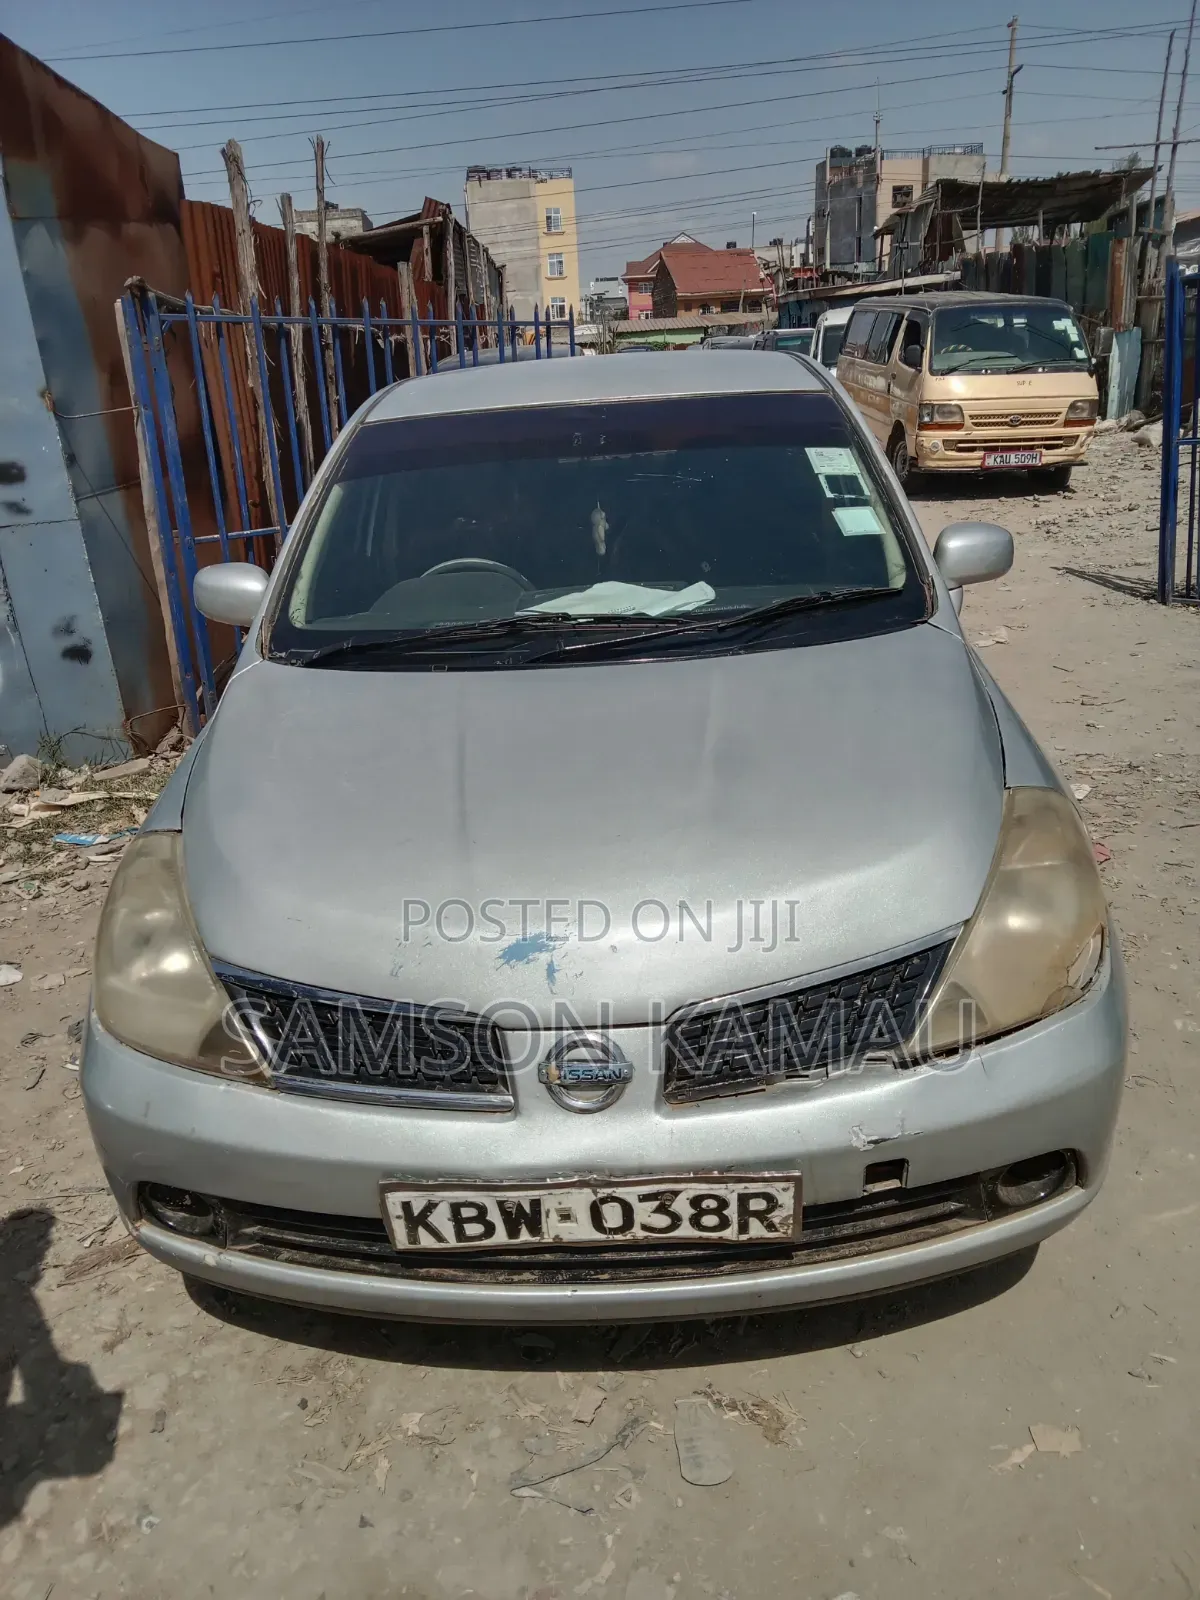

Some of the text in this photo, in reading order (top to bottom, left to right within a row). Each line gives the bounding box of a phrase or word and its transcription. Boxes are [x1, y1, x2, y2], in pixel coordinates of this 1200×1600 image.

[993, 453, 1038, 465] KAU 509H
[549, 1068, 622, 1081] ISSAN
[401, 1190, 781, 1246] KBW 038R
